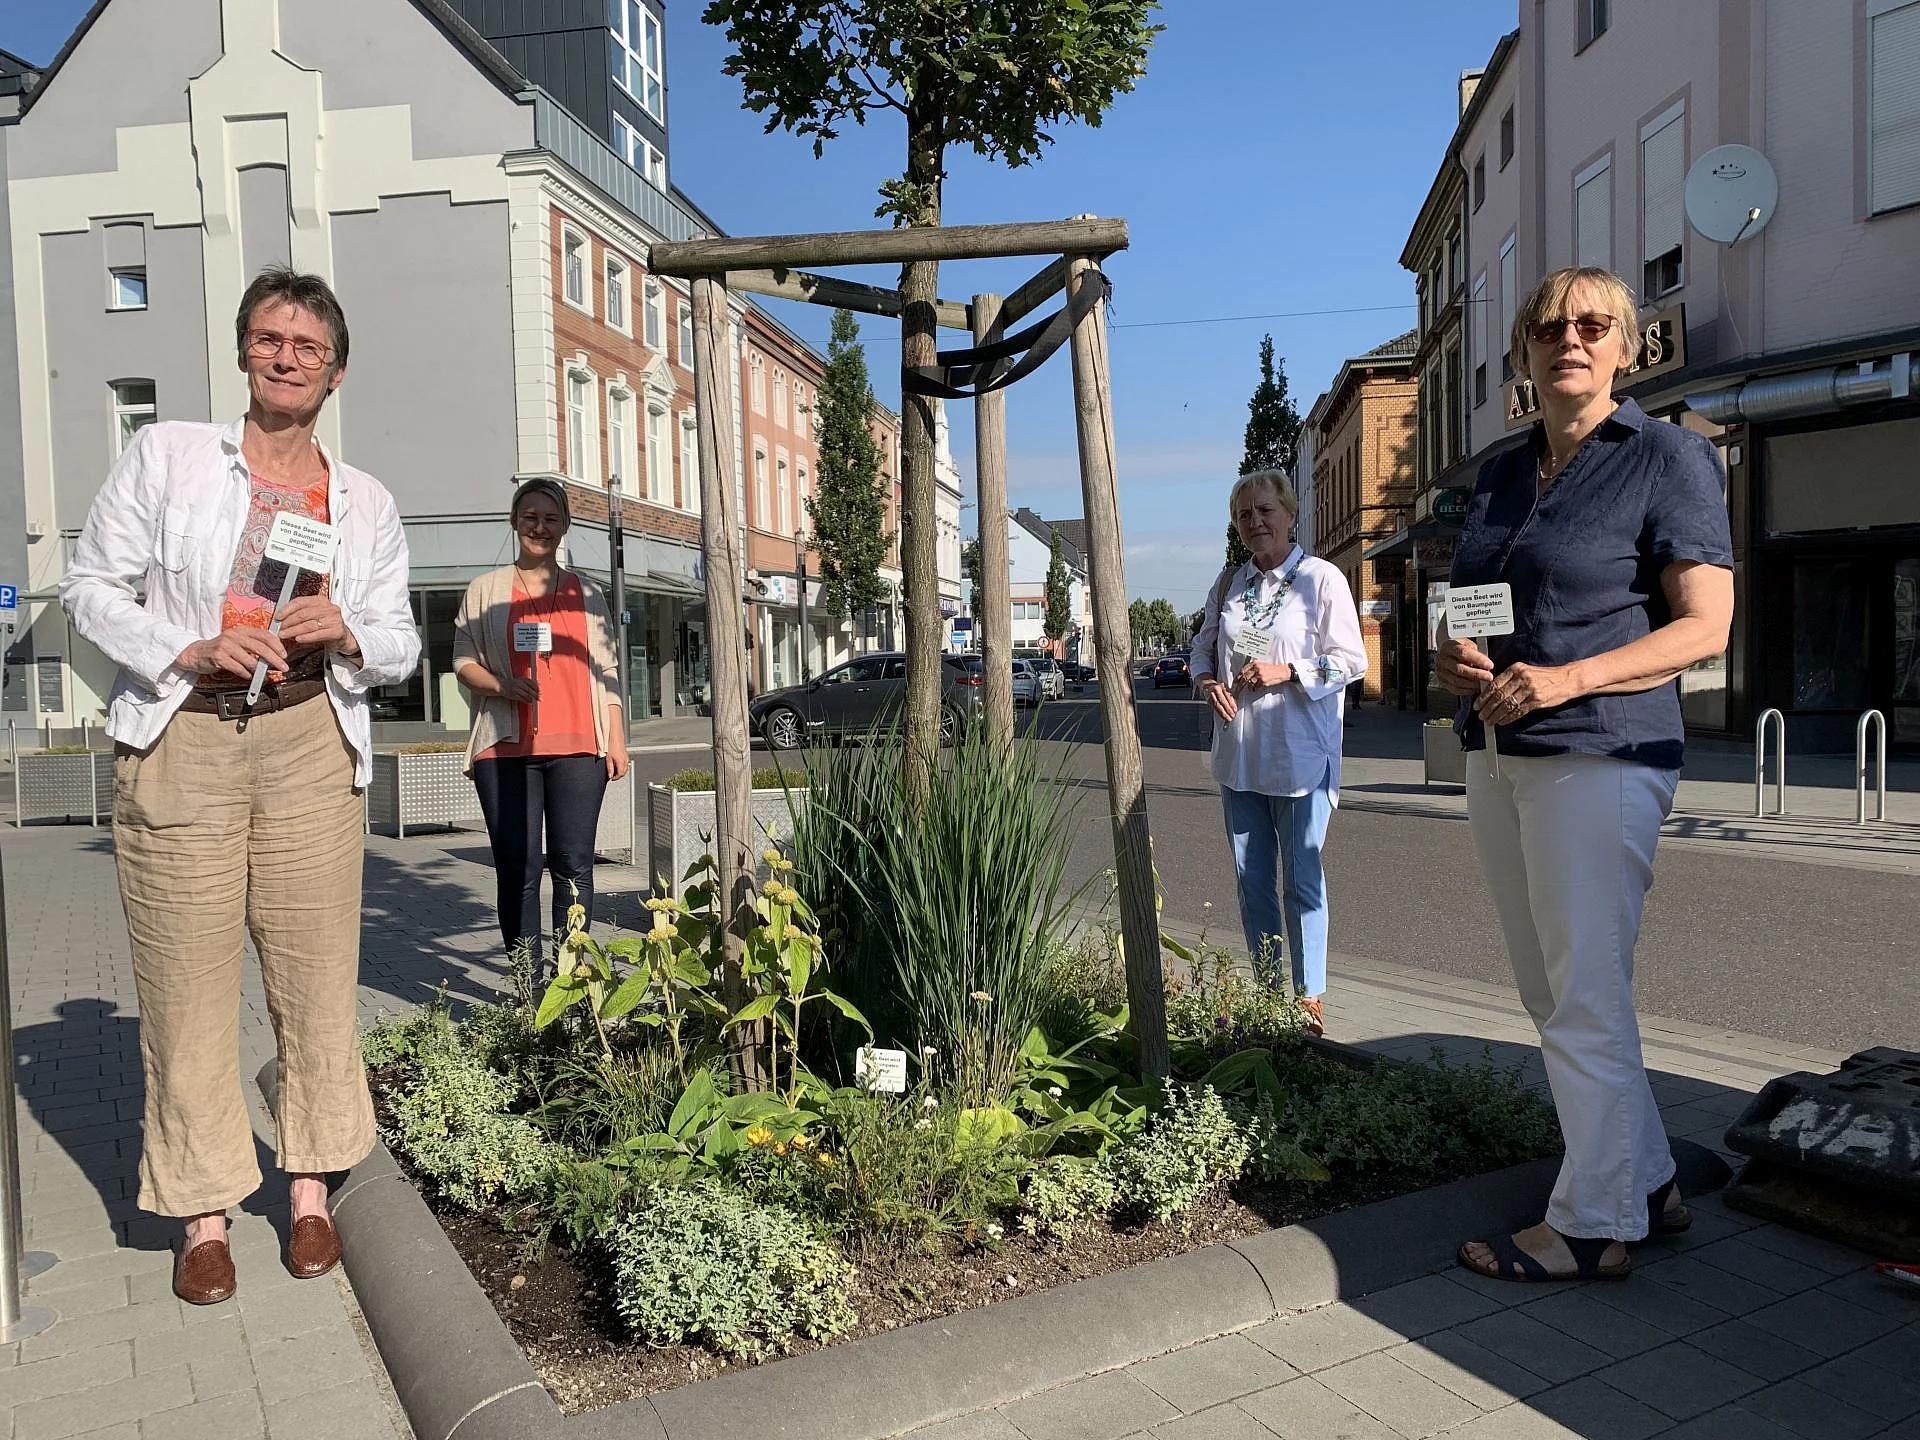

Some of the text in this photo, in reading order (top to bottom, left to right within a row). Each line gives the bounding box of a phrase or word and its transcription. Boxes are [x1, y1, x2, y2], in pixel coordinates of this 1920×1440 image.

[280, 520, 301, 530] Dieses
[303, 526, 317, 535] Beet
[289, 537, 315, 549] gepflegt
[293, 531, 328, 545] Baumpaten
[1467, 600, 1502, 608] Baumpaten
[1466, 609, 1491, 617] gepflegt
